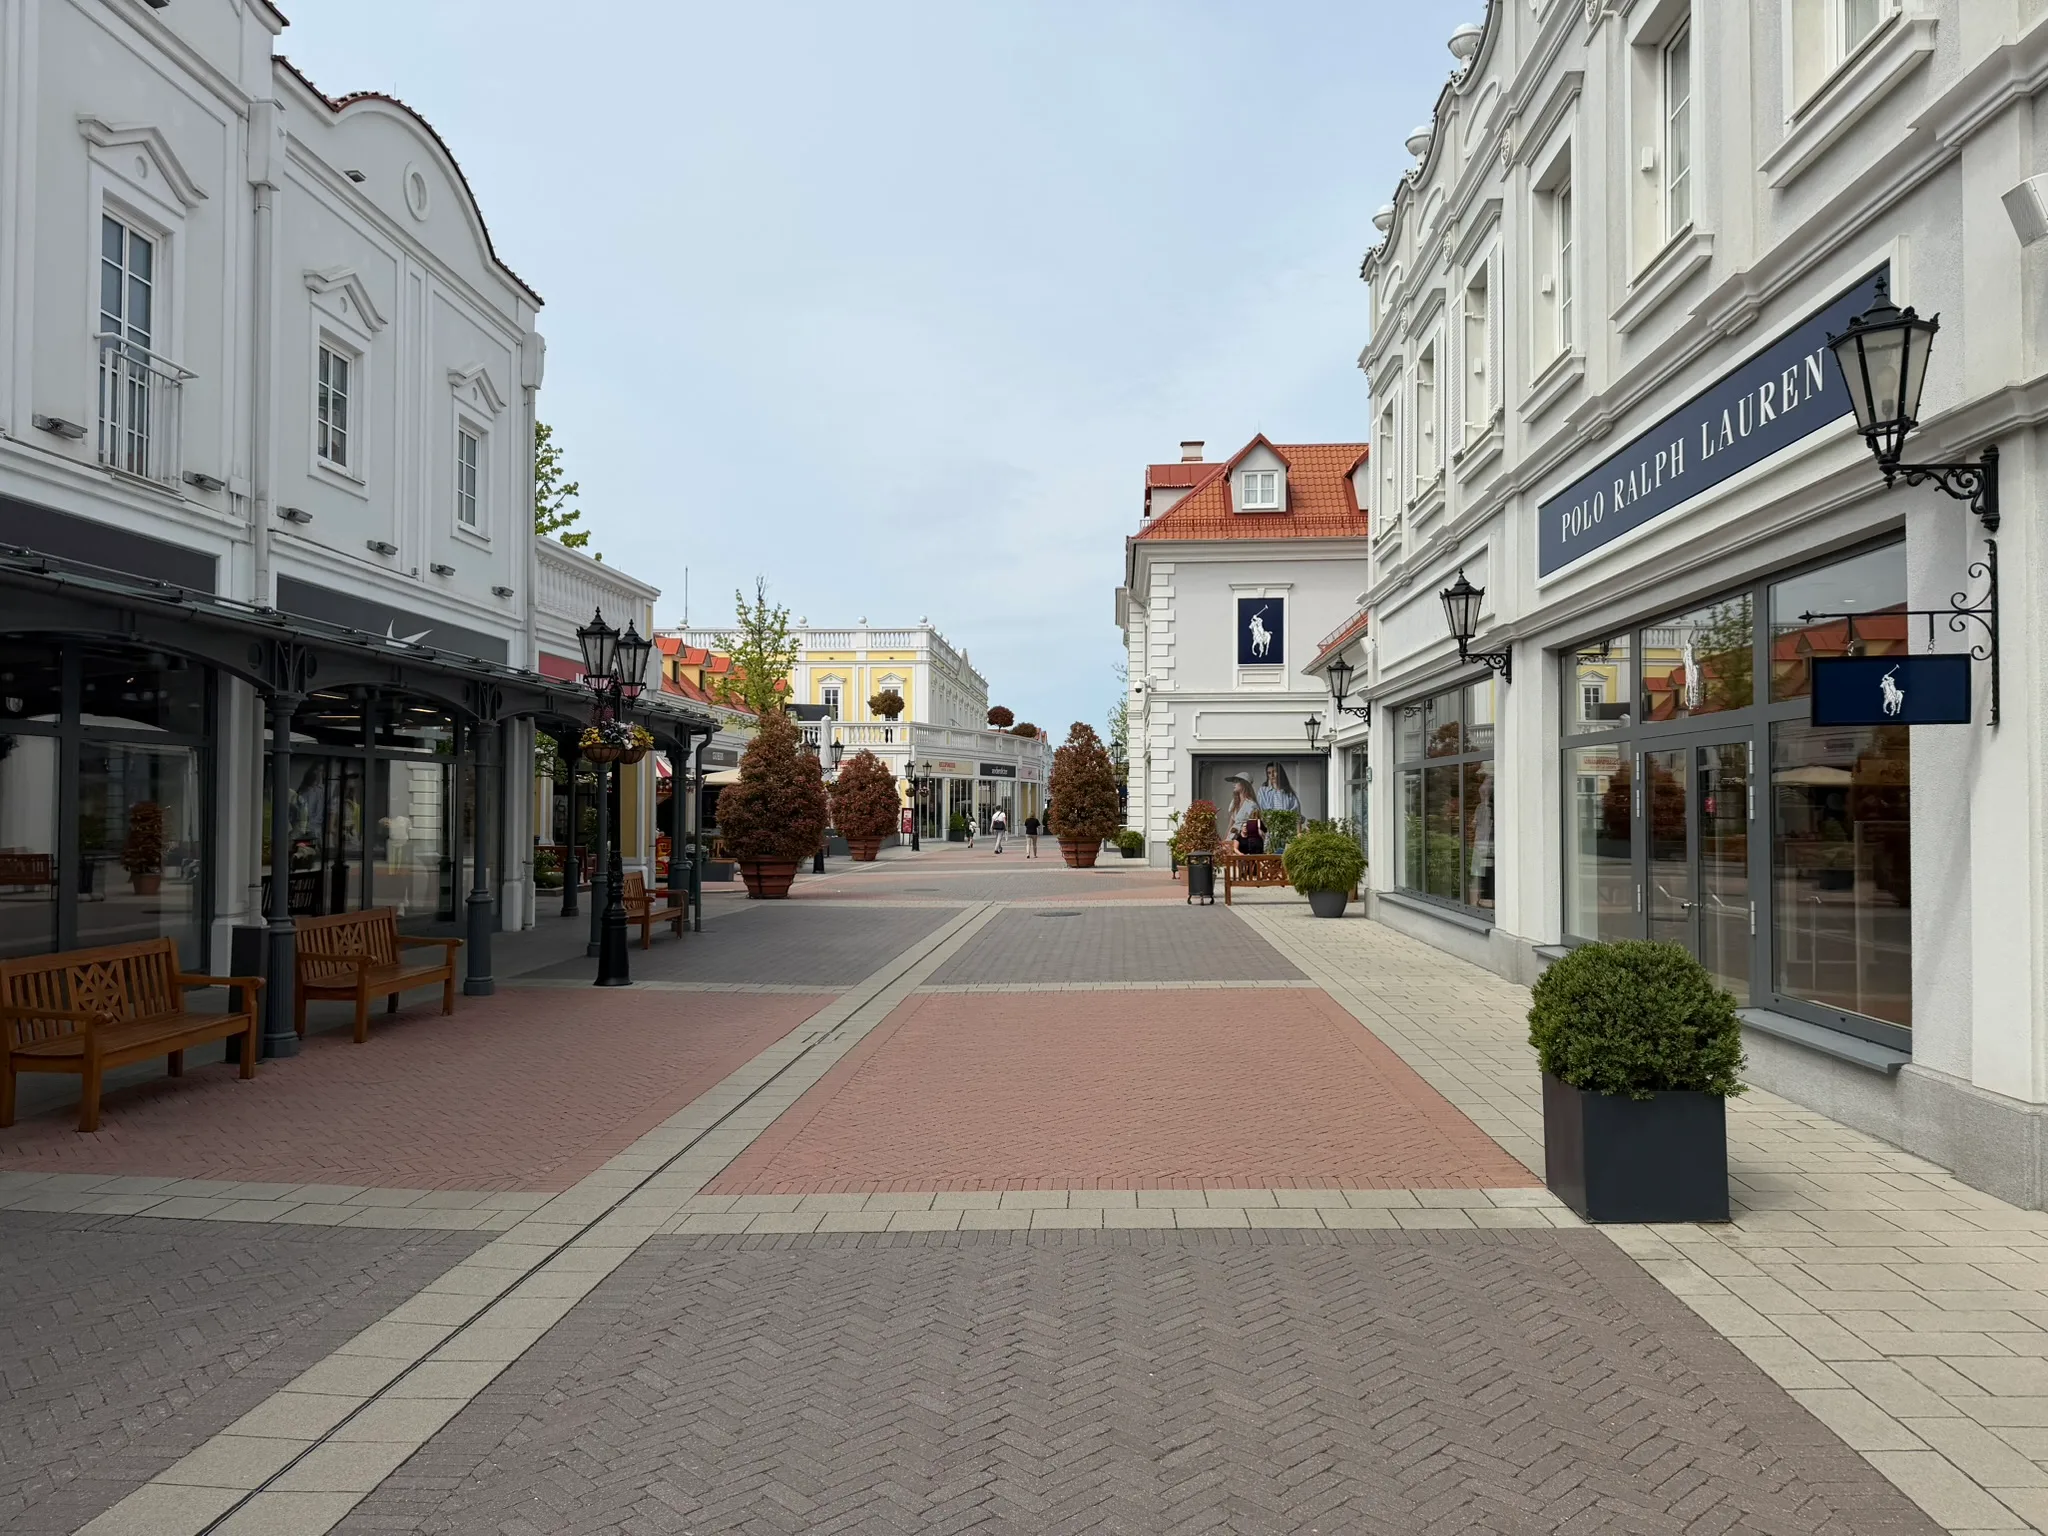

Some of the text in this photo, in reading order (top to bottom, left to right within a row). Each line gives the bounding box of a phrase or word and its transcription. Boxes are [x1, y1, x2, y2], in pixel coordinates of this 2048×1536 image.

[1561, 347, 1825, 543] POLO RALPH LAUREN
